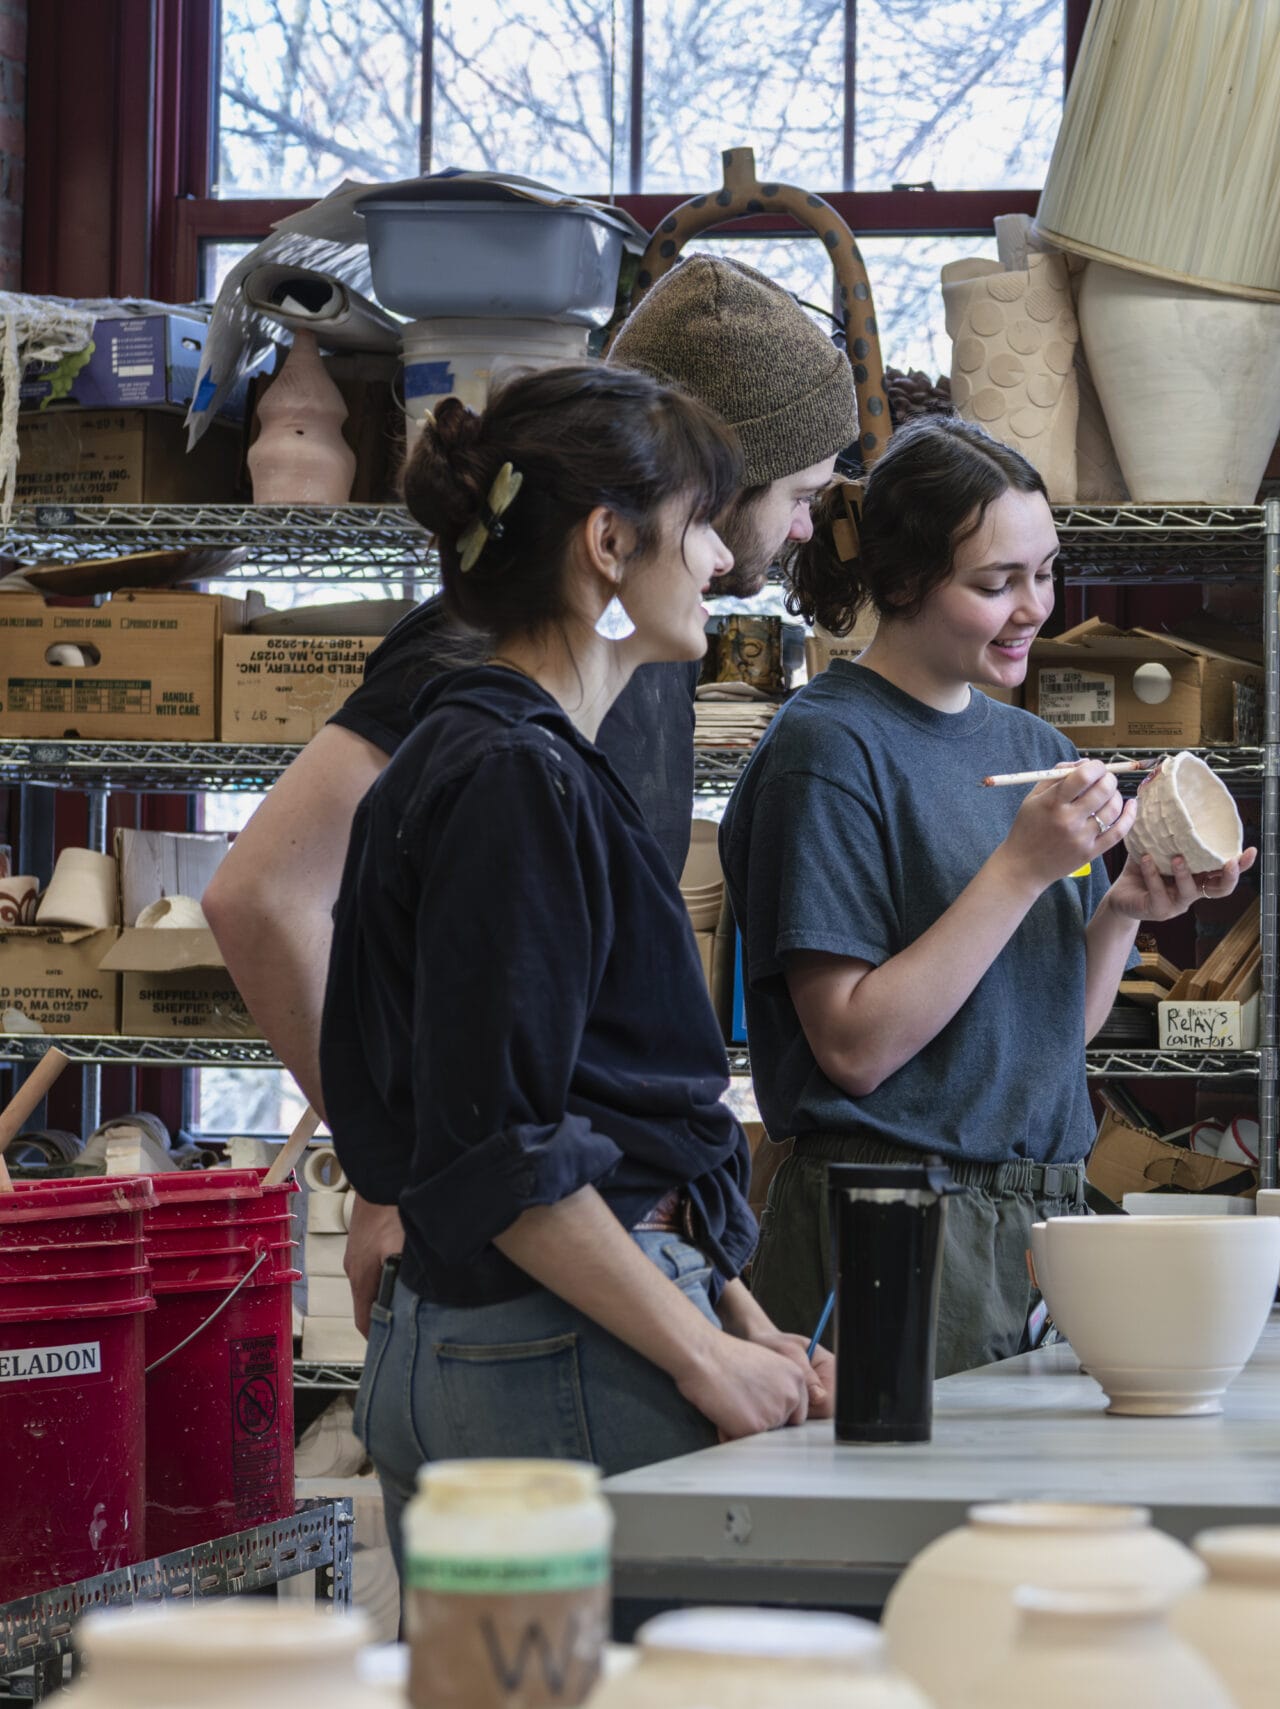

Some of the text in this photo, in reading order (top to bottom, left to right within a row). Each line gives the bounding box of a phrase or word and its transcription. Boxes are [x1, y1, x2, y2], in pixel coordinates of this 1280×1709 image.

[250, 651, 368, 662] EFFIELD, MA 01257
[830, 648, 848, 656] CLAY
[236, 663, 261, 674] INC.
[264, 662, 325, 674] POTTERY,
[162, 691, 194, 703] HANDLE
[156, 704, 200, 716] WITH CARE
[14, 988, 73, 1000] POTTERY,
[77, 988, 103, 999] INC.
[30, 1001, 49, 1010] MA
[53, 1001, 89, 1012] 01257
[0, 1348, 96, 1377] ELADON
[477, 1612, 581, 1698] W
